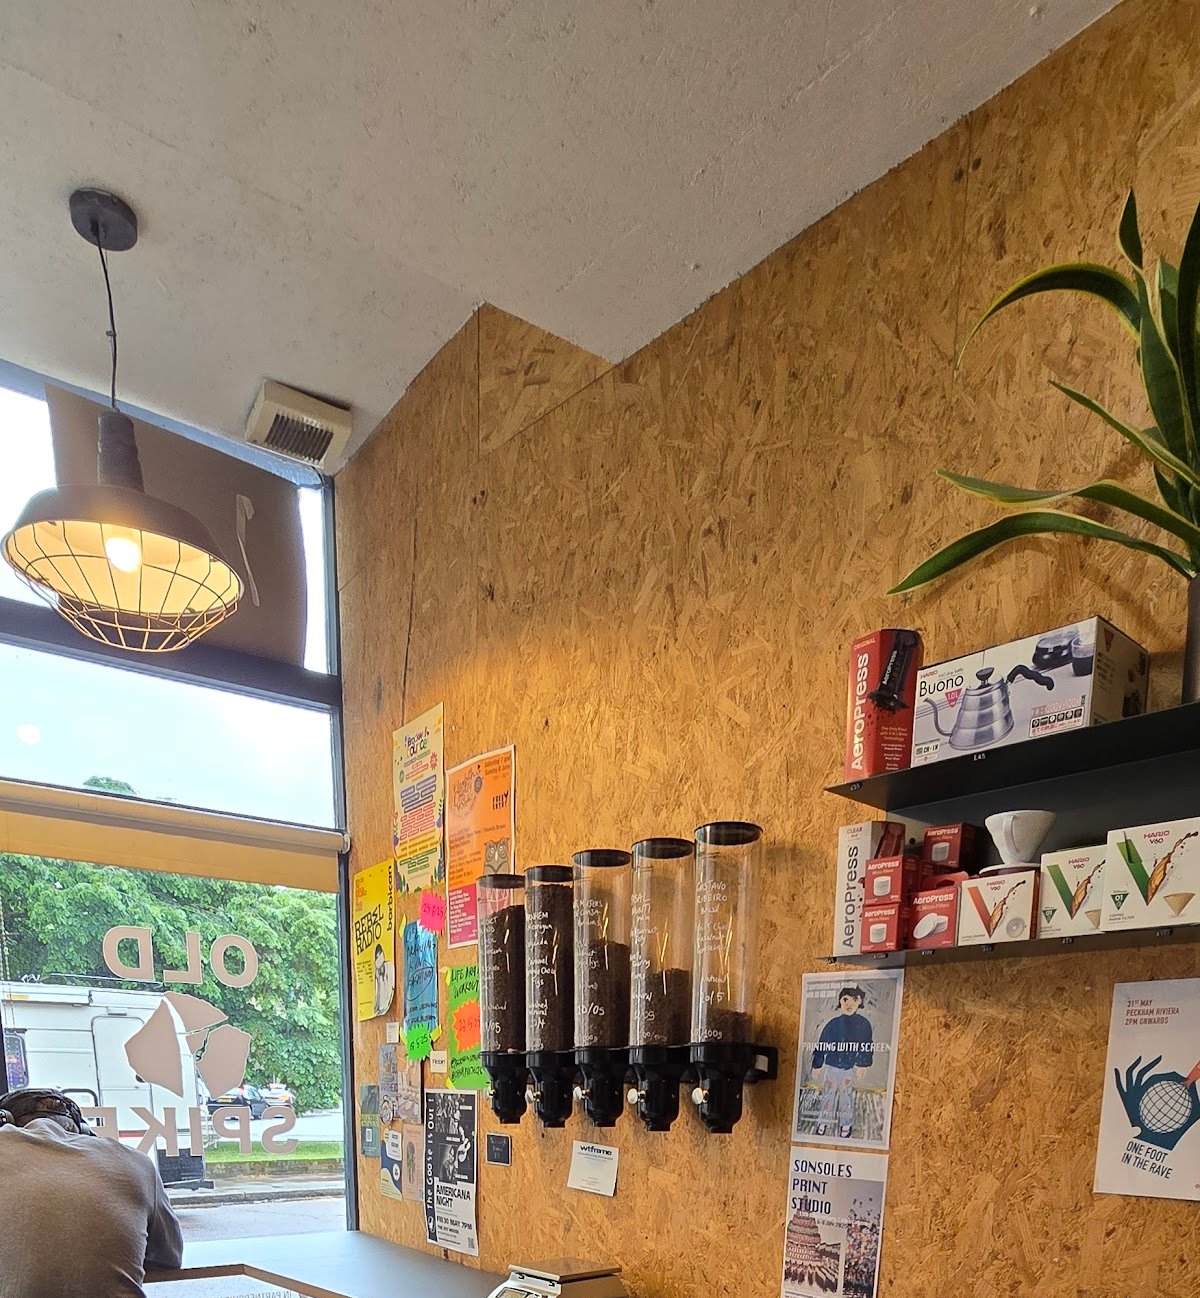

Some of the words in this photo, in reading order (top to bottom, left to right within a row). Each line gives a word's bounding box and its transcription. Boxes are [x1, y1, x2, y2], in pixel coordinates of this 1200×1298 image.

[919, 675, 964, 697] Buono
[851, 653, 869, 770] AeroPress
[927, 827, 959, 837] AeroPress
[1143, 830, 1170, 839] HARIO
[868, 861, 899, 870] AeroPress
[842, 845, 859, 948] AeroPress
[913, 893, 954, 905] AeroPress
[864, 909, 896, 917] AeroPress
[356, 923, 382, 956] RADIO
[1125, 1008, 1155, 1016] PECKHAM
[1156, 1007, 1180, 1015] RIVIERA
[1139, 1016, 1169, 1025] ONWARDS
[803, 1041, 835, 1052] PRINTING
[837, 1042, 859, 1052] WITH
[860, 1042, 892, 1053] SCREEN
[1126, 1141, 1145, 1155] ONE
[1144, 1147, 1168, 1163] FOOT
[793, 1159, 853, 1178] SONSOLES
[1121, 1152, 1133, 1165] IN
[1132, 1156, 1150, 1171] THE
[1148, 1162, 1173, 1179] RAVE
[436, 1185, 471, 1201] AMERICANA
[792, 1178, 828, 1195] PRINT
[436, 1195, 453, 1208] NIGHT
[791, 1197, 832, 1215] STUDIO
[450, 1218, 460, 1227] MAY
[461, 1222, 472, 1230] 7PM
